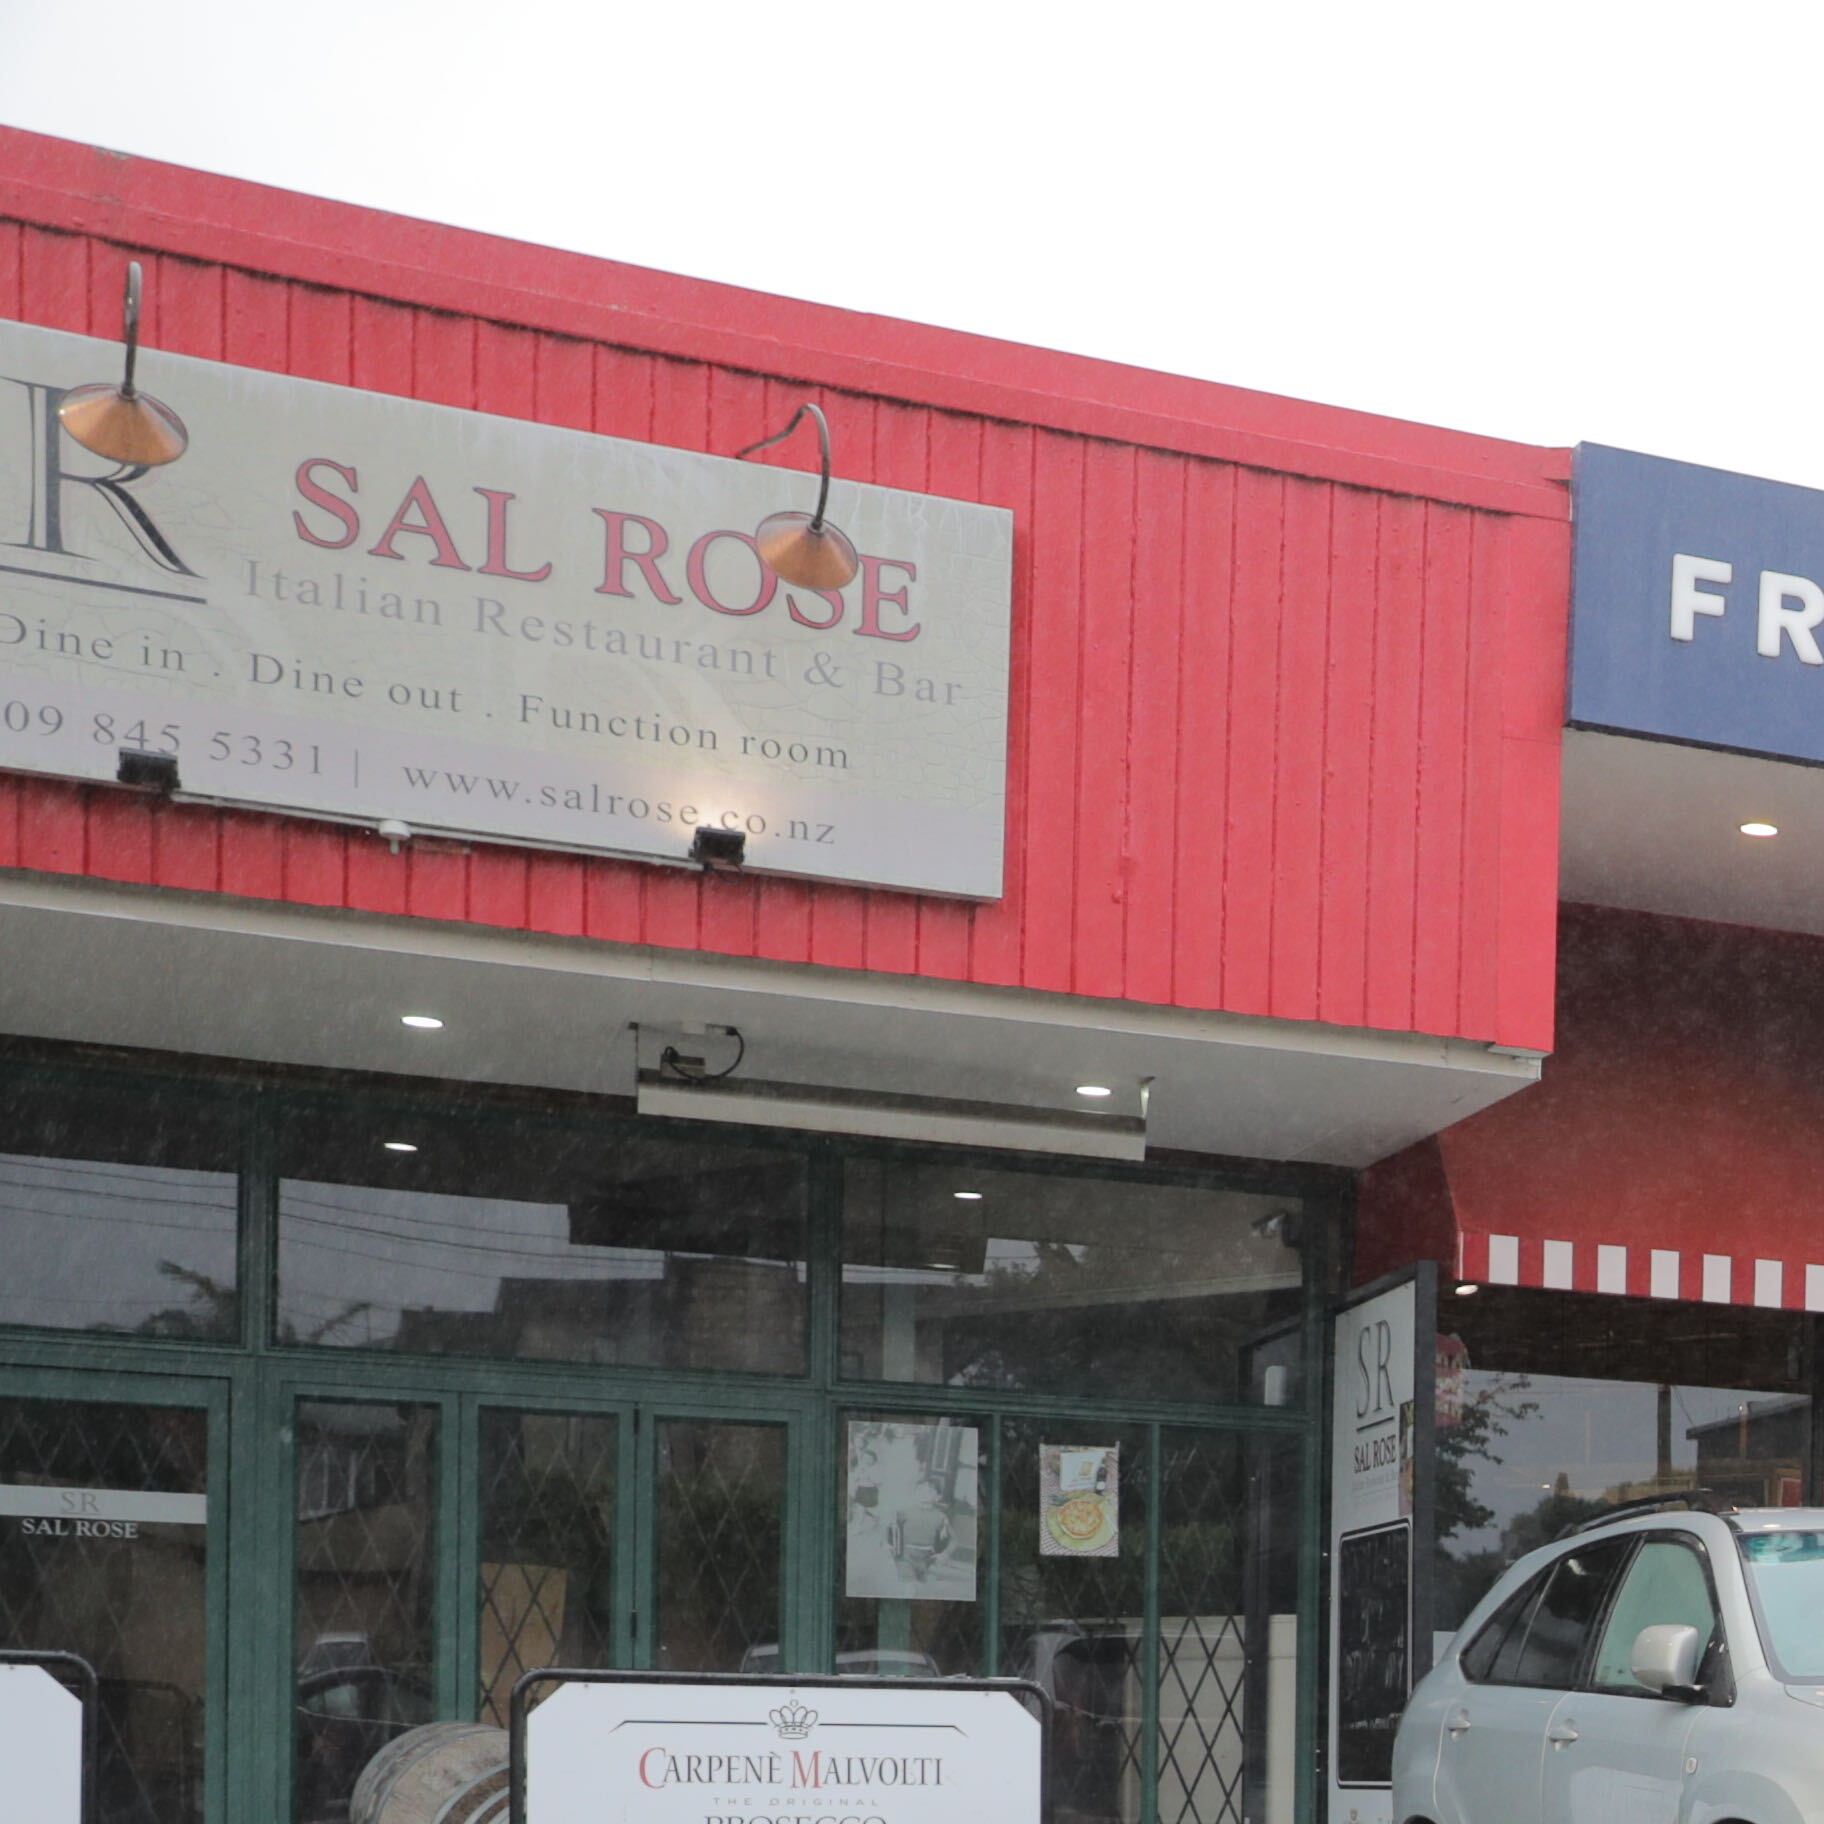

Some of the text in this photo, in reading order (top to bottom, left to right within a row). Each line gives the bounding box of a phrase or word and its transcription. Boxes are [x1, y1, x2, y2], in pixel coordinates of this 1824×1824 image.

[291, 457, 554, 584] SAL
[243, 559, 964, 706] Italian Restaurant & Bar
[0, 612, 850, 770] Dine in Dine out Function room
[2, 700, 837, 847] 09 845 5331 www.salrose.co.nz
[1356, 1319, 1394, 1418] SR
[1353, 1434, 1396, 1474] SAL ROSE
[21, 1518, 139, 1539] SAL ROSE
[61, 1491, 100, 1513] SR
[638, 1746, 945, 1790] CARPENÈ MALVOLTI
[712, 1797, 880, 1808] THE ORIGINAL
